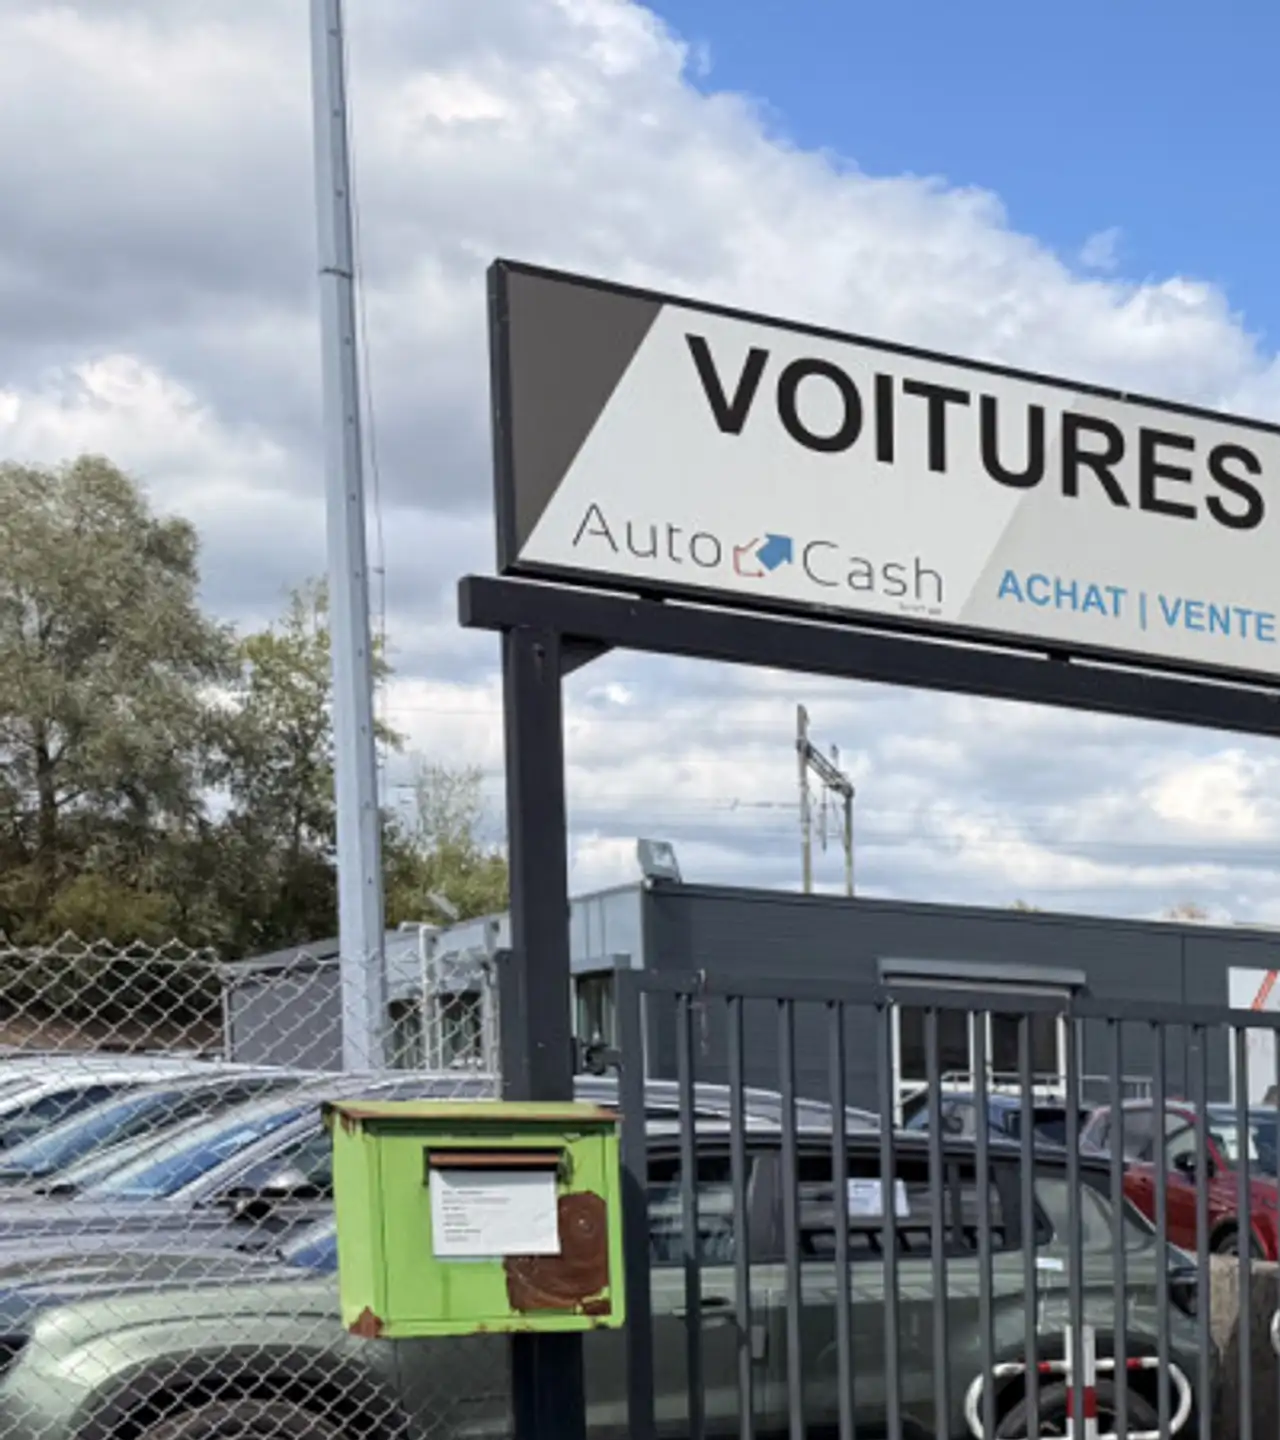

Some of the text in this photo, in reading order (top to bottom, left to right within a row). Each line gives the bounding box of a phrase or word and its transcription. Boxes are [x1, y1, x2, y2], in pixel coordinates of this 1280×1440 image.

[685, 333, 1265, 530] VOITURES
[572, 503, 944, 604] Auto Cash
[997, 569, 1127, 618] ACHAT
[1157, 593, 1277, 644] VENTE
